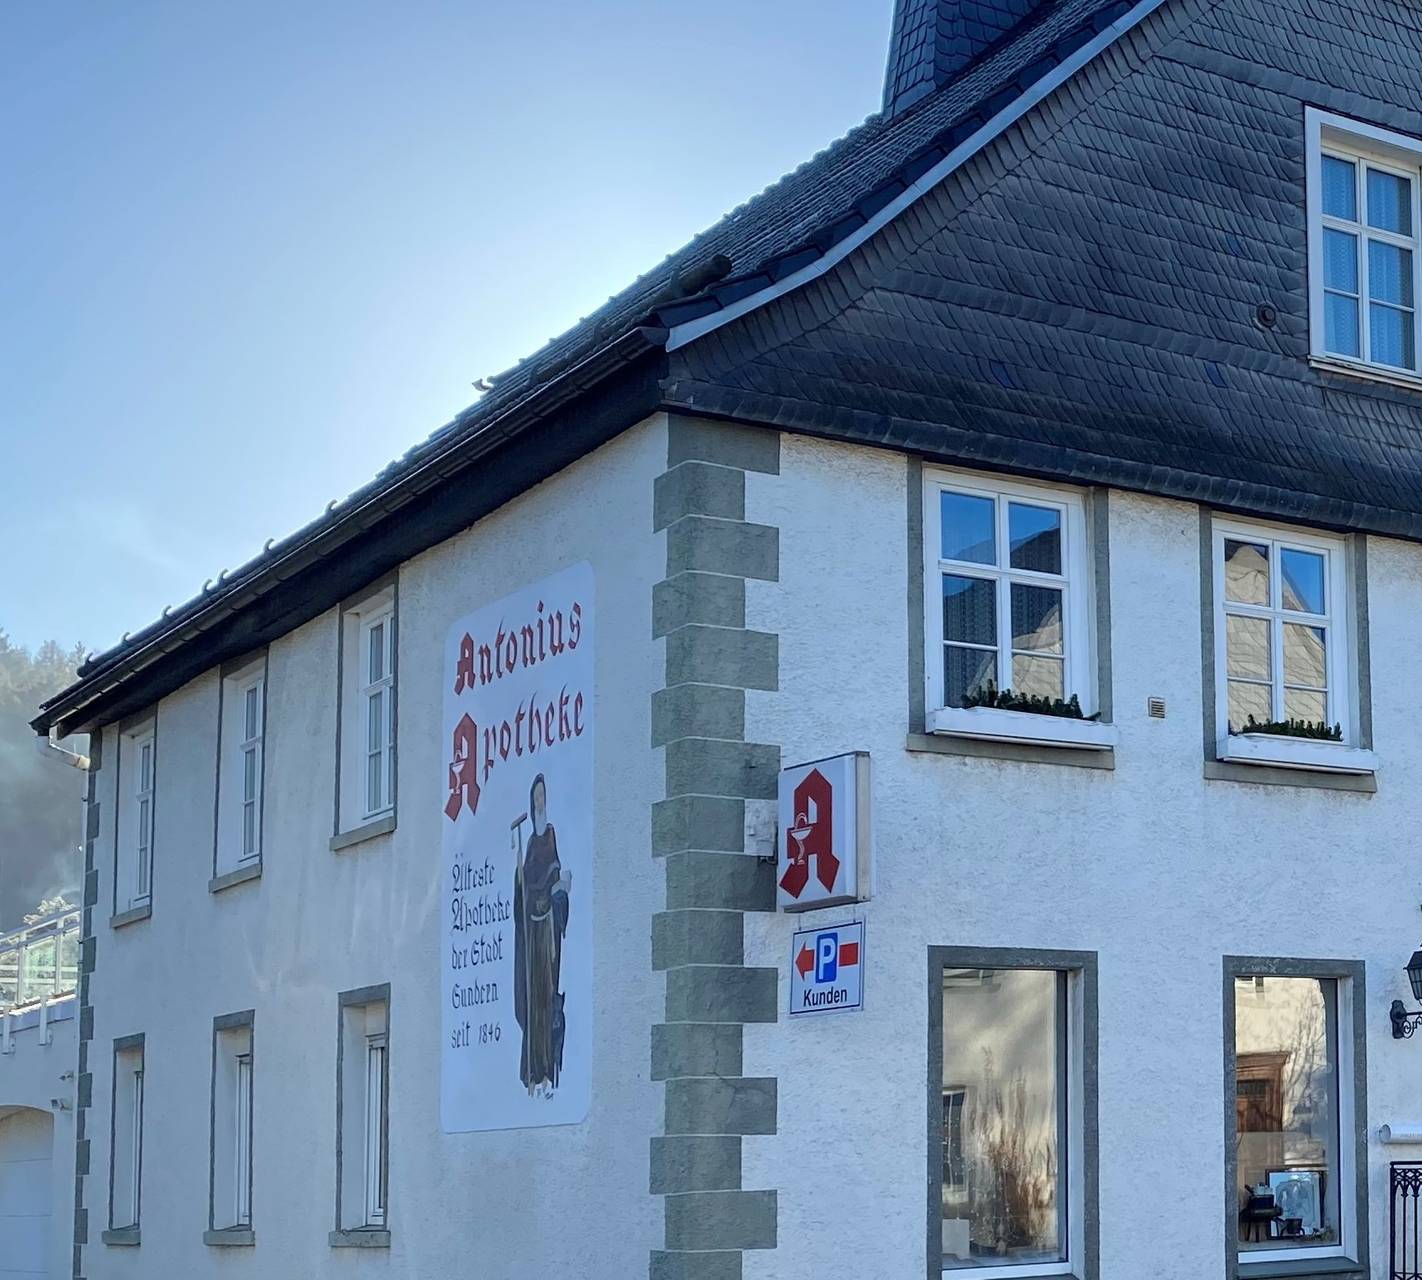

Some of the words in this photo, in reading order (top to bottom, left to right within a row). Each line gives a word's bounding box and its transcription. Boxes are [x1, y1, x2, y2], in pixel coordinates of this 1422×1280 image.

[454, 600, 582, 696] Antonius
[444, 682, 584, 822] Apotheke
[451, 891, 511, 934] Apotheke
[451, 943, 468, 970] der
[472, 931, 504, 967] Stadt
[803, 986, 848, 1007] Kunden
[451, 1020, 471, 1049] seit
[479, 1021, 502, 1046] 1846
